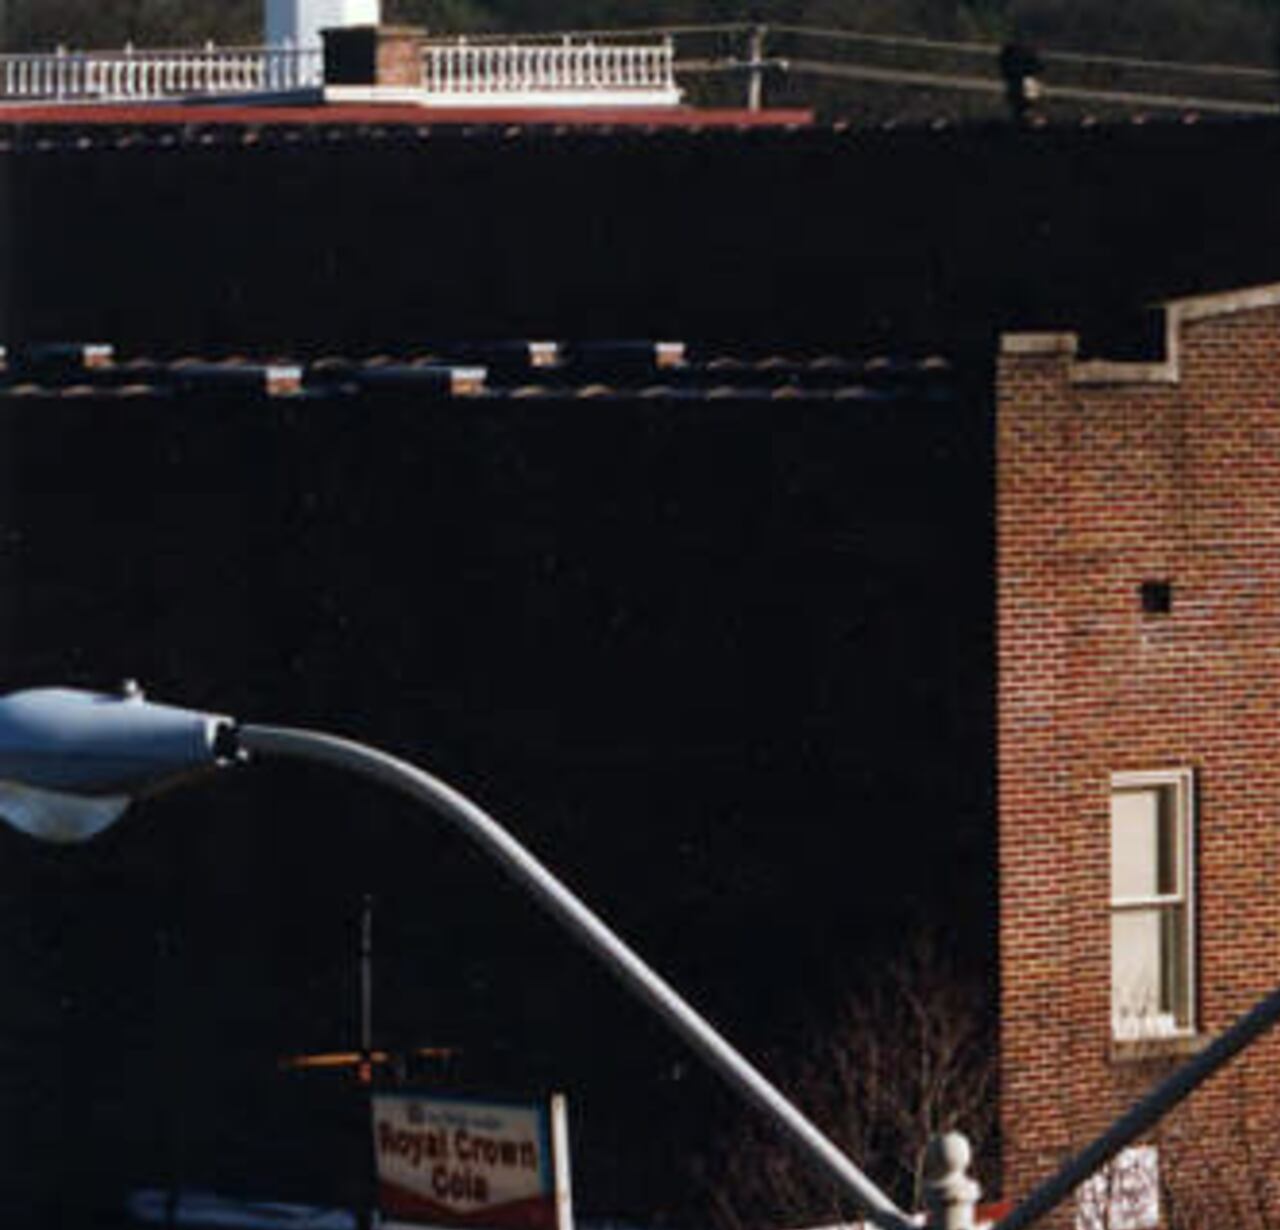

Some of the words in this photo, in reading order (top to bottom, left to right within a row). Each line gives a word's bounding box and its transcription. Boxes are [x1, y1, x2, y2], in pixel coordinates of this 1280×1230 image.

[378, 1120, 447, 1168] Royal
[454, 1128, 537, 1171] Crown
[432, 1165, 489, 1200] Cola
